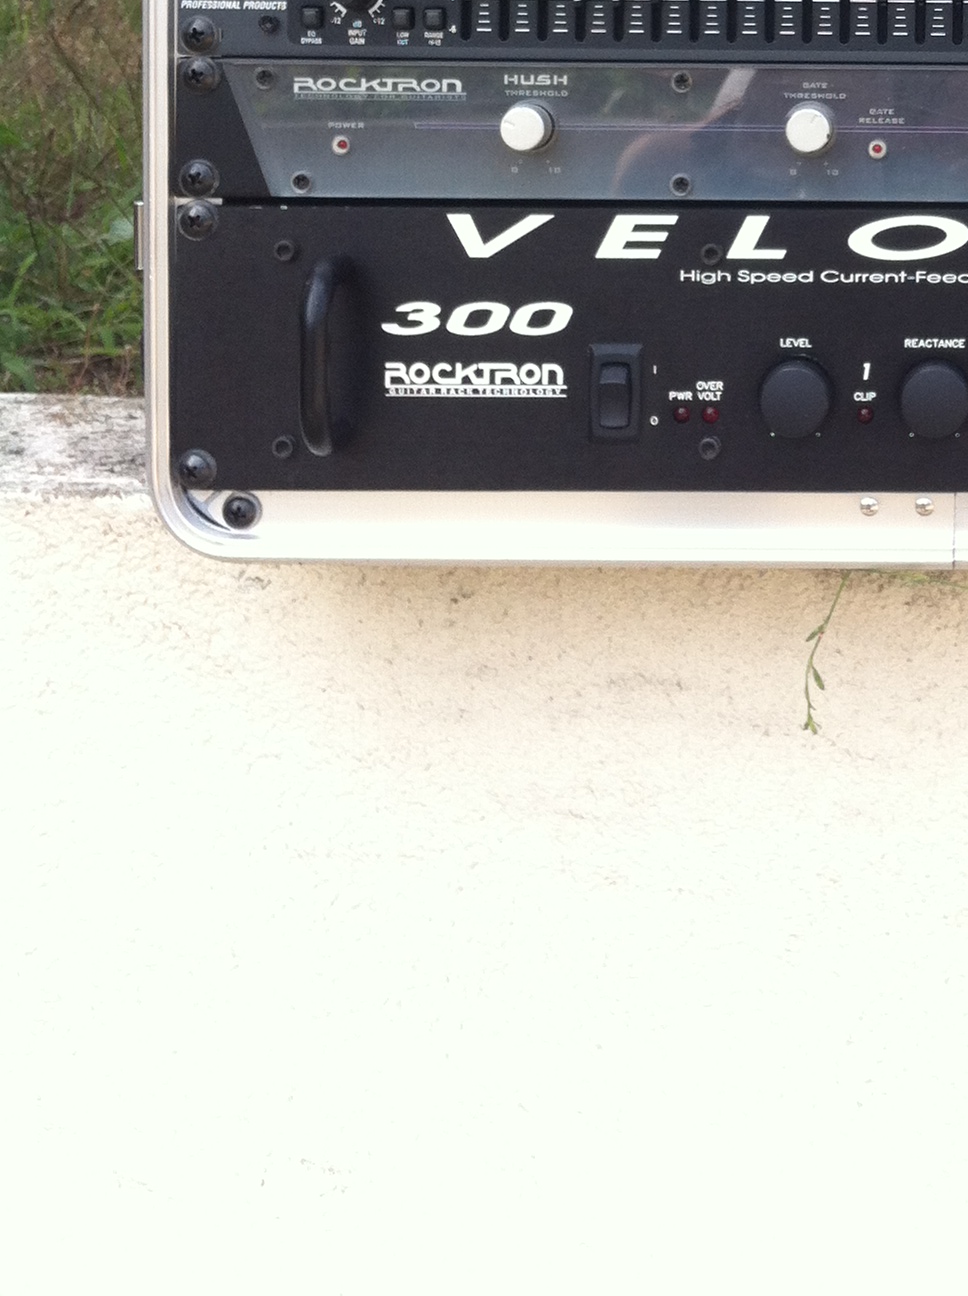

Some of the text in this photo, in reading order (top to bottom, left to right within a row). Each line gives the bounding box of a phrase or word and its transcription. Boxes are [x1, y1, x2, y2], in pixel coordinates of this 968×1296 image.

[181, 0, 287, 11] PROFESSIONAL PRODUCTS
[293, 78, 462, 92] ROCKTRON
[504, 74, 568, 86] HUSH
[504, 89, 568, 97] THRESHOLD
[680, 269, 732, 287] High
[737, 269, 814, 287] Speed
[381, 301, 573, 336] 300
[780, 338, 811, 348] LEVEL
[904, 338, 965, 349] REACTANCE
[385, 362, 564, 385] ROCKTRON
[863, 363, 870, 380] 1
[696, 381, 723, 391] OVER
[388, 388, 435, 396] GUITAR
[479, 388, 562, 396] TECHNOLOGY
[669, 391, 692, 401] PWR
[697, 391, 722, 401] VOLT
[854, 392, 876, 401] CLIP
